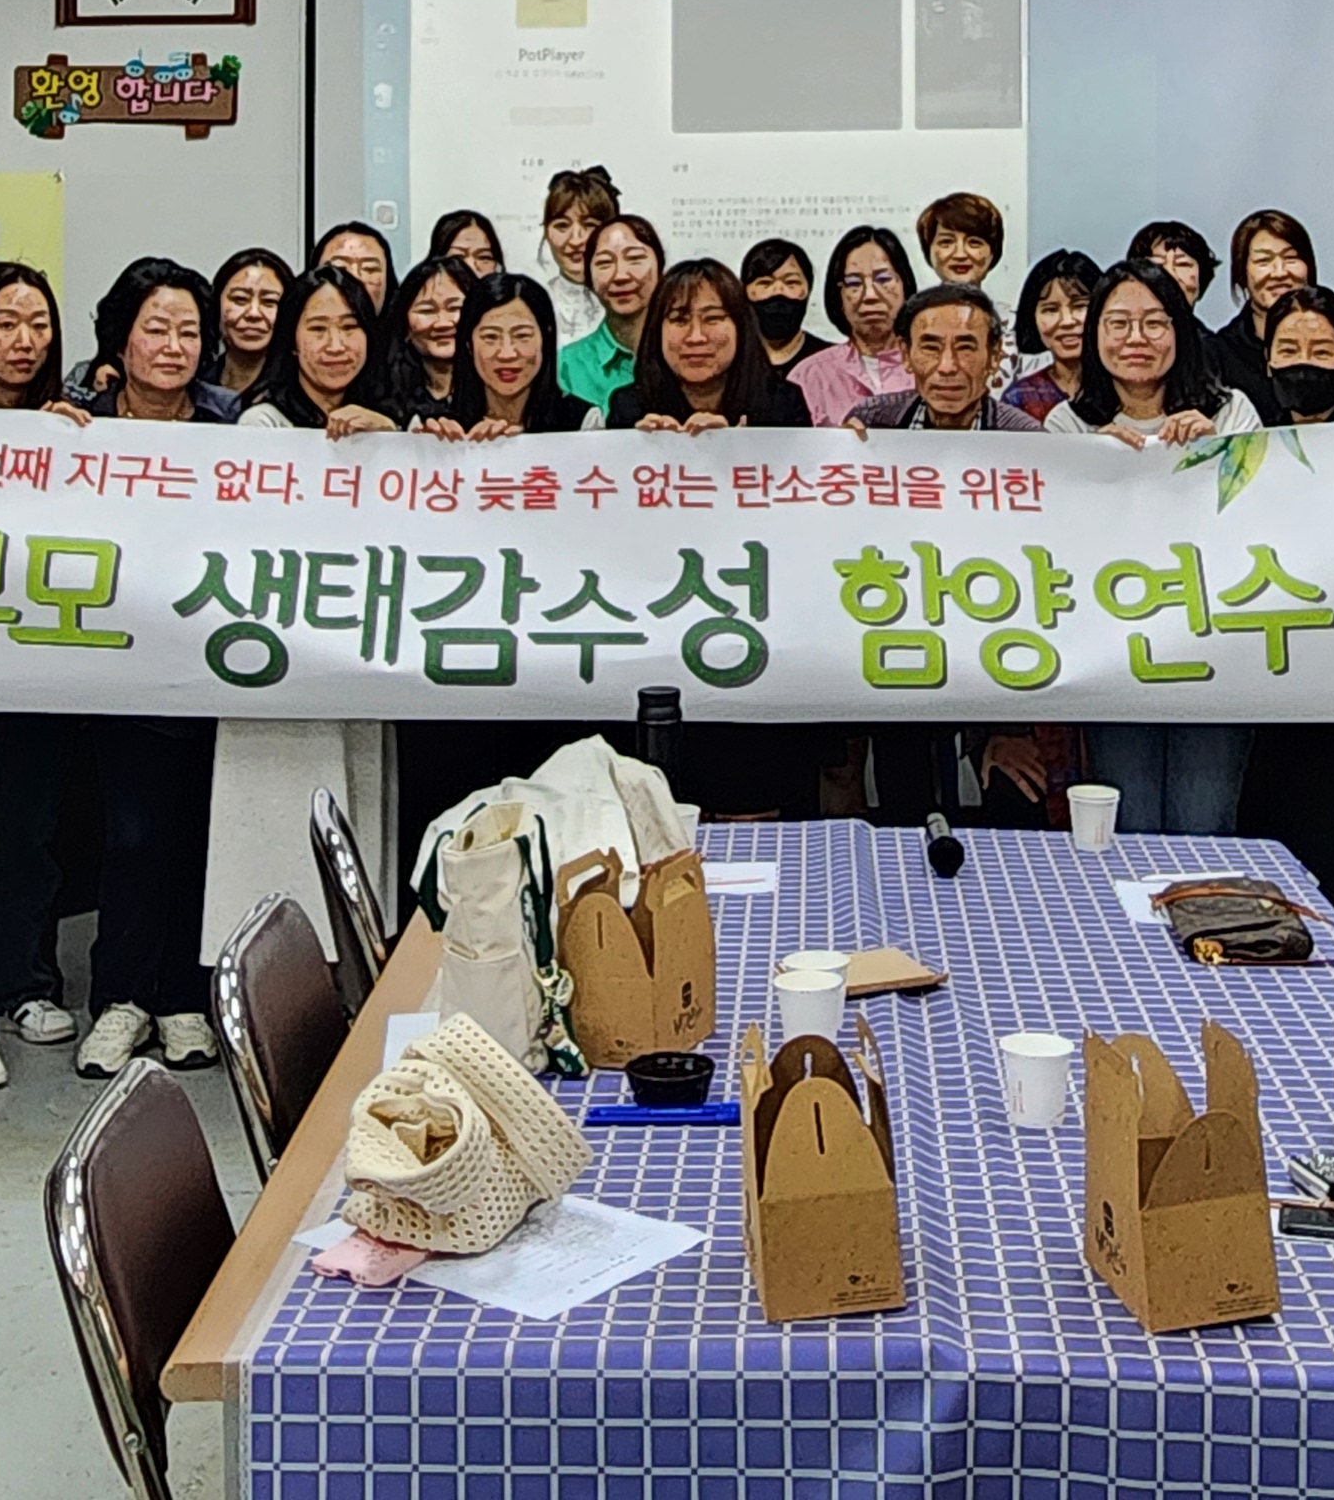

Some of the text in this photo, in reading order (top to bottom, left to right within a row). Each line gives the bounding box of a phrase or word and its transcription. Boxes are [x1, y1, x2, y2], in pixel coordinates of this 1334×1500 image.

[518, 47, 585, 65] PotPlayer
[30, 67, 219, 115] 환영 합니다
[65, 452, 198, 499] 지구는
[213, 459, 305, 505] 없다.
[322, 464, 362, 507] 더
[378, 466, 465, 512] 이상
[474, 465, 562, 511] 늦출
[572, 465, 618, 509] 수
[632, 463, 718, 509] 없는
[731, 463, 947, 510] 탄소중립을
[958, 466, 1045, 512] 위한
[171, 540, 771, 690] 생태감수성
[830, 540, 1075, 690] 함양
